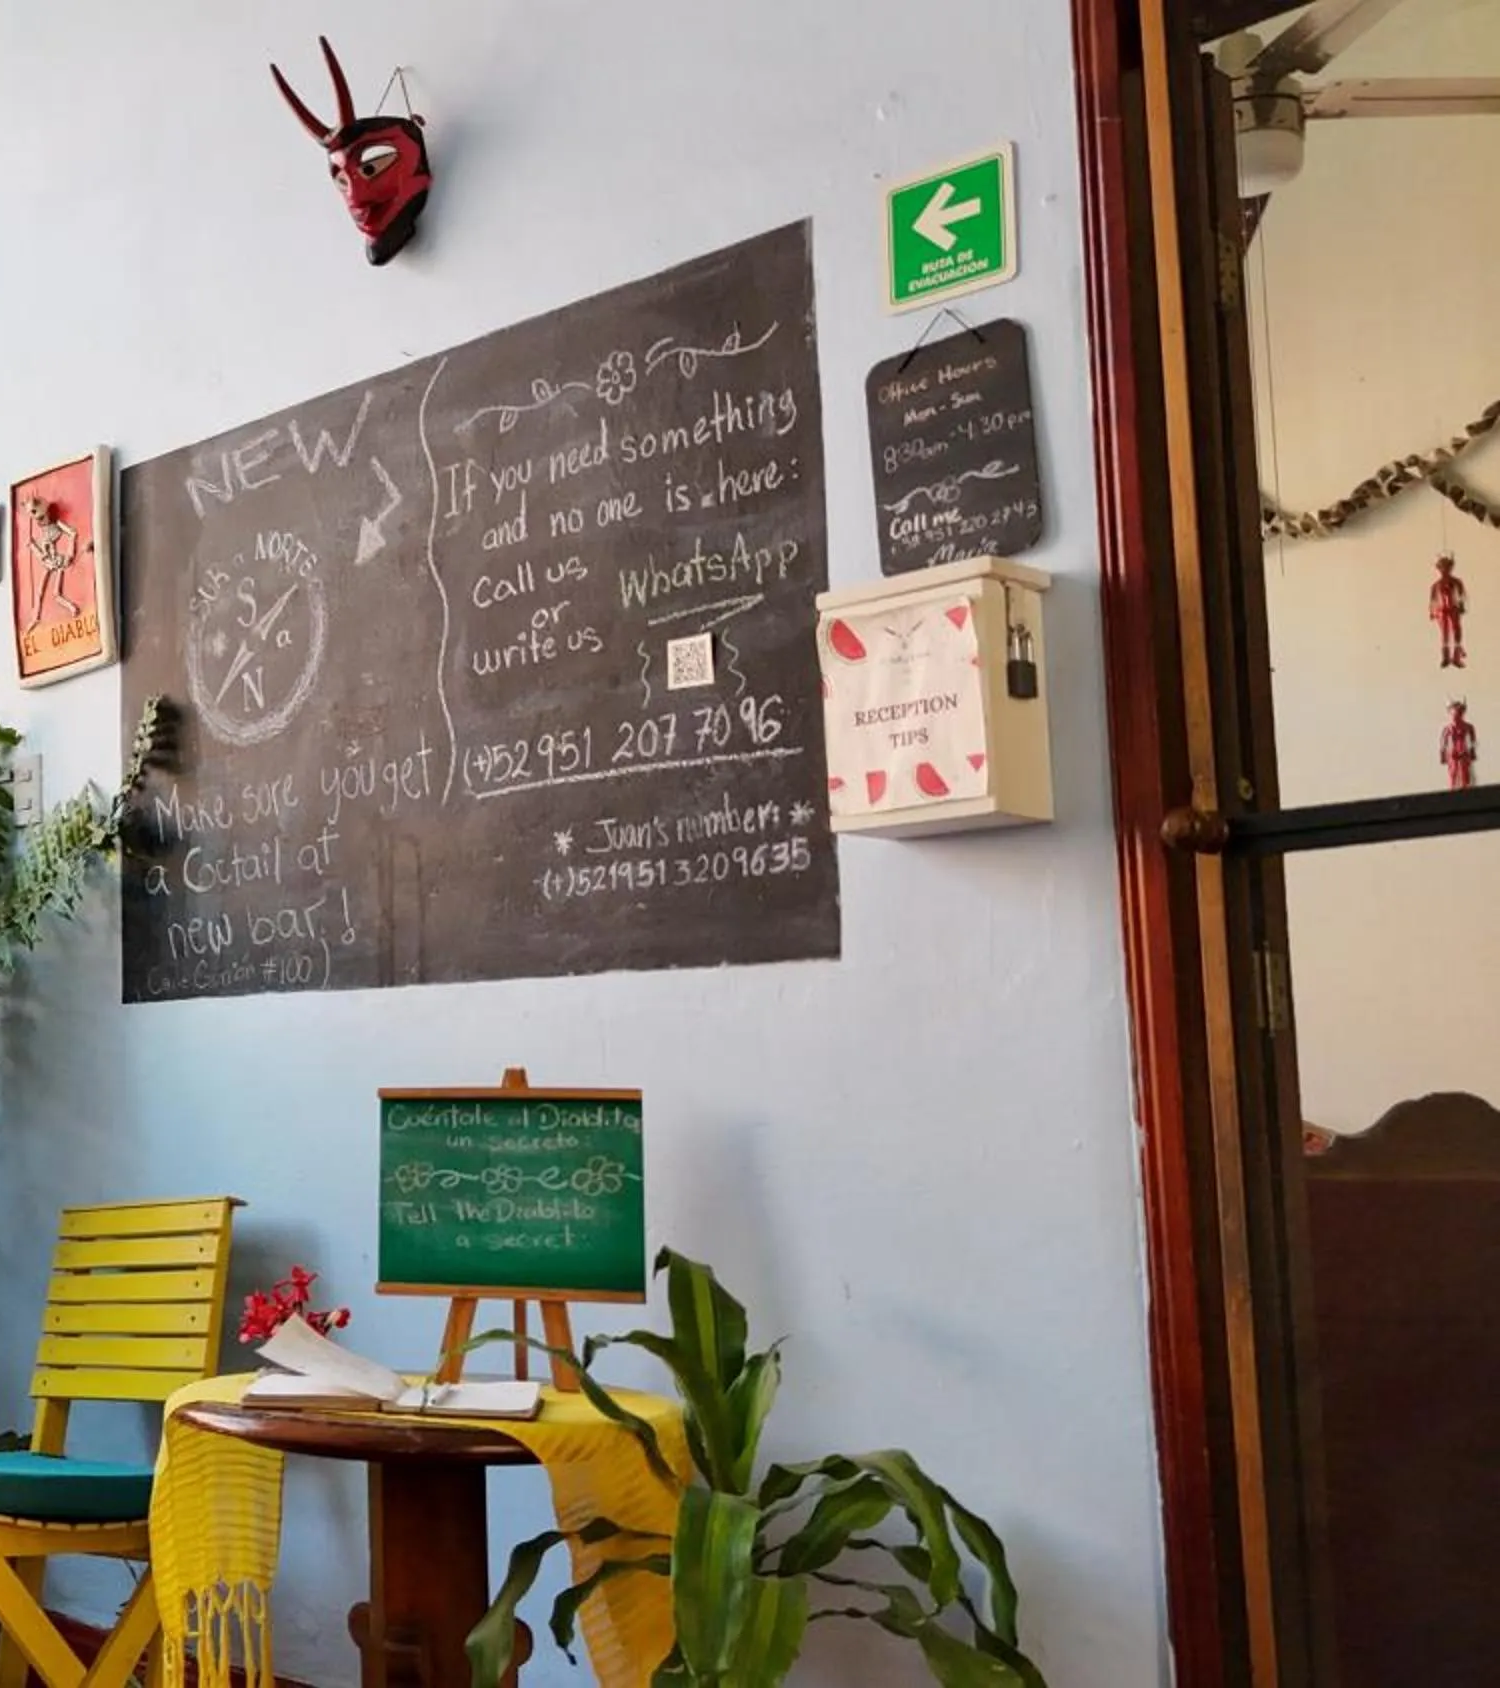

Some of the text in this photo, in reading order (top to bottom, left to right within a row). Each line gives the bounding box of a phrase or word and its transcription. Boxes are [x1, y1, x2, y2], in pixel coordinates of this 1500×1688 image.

[922, 249, 975, 274] RUTA DE
[938, 356, 997, 384] Hours
[186, 390, 372, 518] NEW
[442, 388, 800, 519] If you need something
[482, 457, 800, 551] and no one is here:
[890, 514, 927, 540] Call
[473, 556, 588, 608] Call us
[618, 532, 800, 609] WhatsApp
[531, 600, 570, 630] or
[24, 635, 41, 657] EL
[472, 626, 603, 675] write us
[854, 694, 959, 727] RECEPTION
[537, 727, 592, 784] 951
[612, 713, 676, 762] 207
[693, 704, 731, 750] 70
[739, 695, 783, 745] 96
[889, 727, 930, 749] TIPS
[155, 729, 432, 843] Make sure you get
[586, 816, 670, 854] Juan's
[145, 865, 171, 896] a
[298, 828, 341, 876] at
[167, 912, 233, 960] new
[446, 1133, 472, 1148] un
[392, 1200, 437, 1224] Tell
[456, 1234, 470, 1249] a
